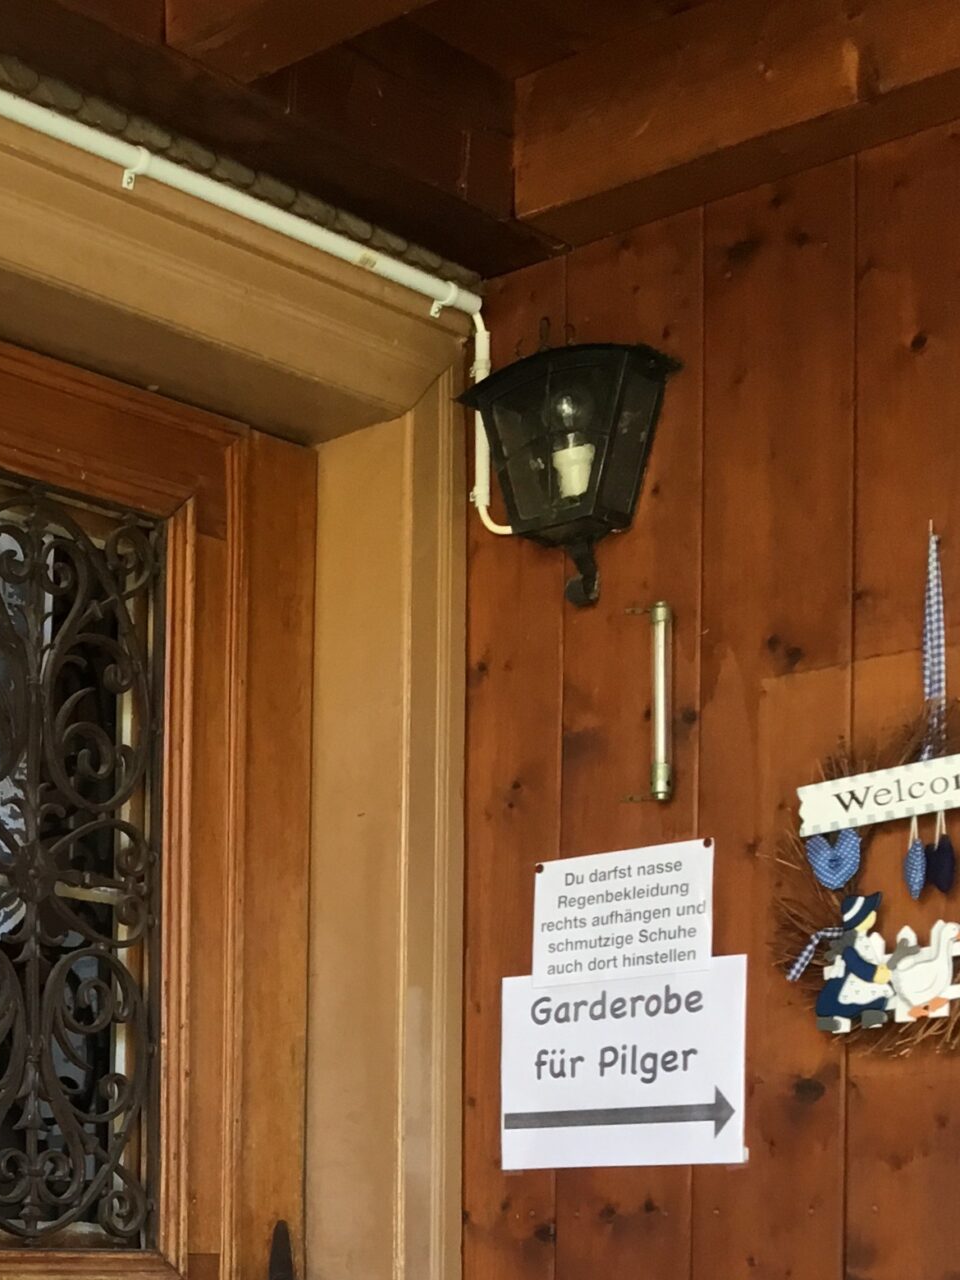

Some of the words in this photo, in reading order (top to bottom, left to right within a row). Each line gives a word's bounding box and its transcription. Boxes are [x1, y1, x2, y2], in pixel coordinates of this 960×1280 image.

[564, 872, 585, 887] Du
[589, 864, 632, 884] darfst
[636, 860, 683, 881] nasse
[557, 882, 690, 910] Regenbekleidung
[540, 916, 587, 933] rechts
[591, 906, 671, 928] aufhängen
[676, 900, 707, 917] und
[547, 933, 634, 954] schmutzige
[638, 925, 697, 944] Schuhe
[546, 959, 583, 976] auch
[587, 955, 618, 972] dort
[622, 949, 697, 968] hinstellen
[530, 984, 705, 1026] Garderobe
[534, 1048, 585, 1081] für
[598, 1044, 699, 1085] Pilger
